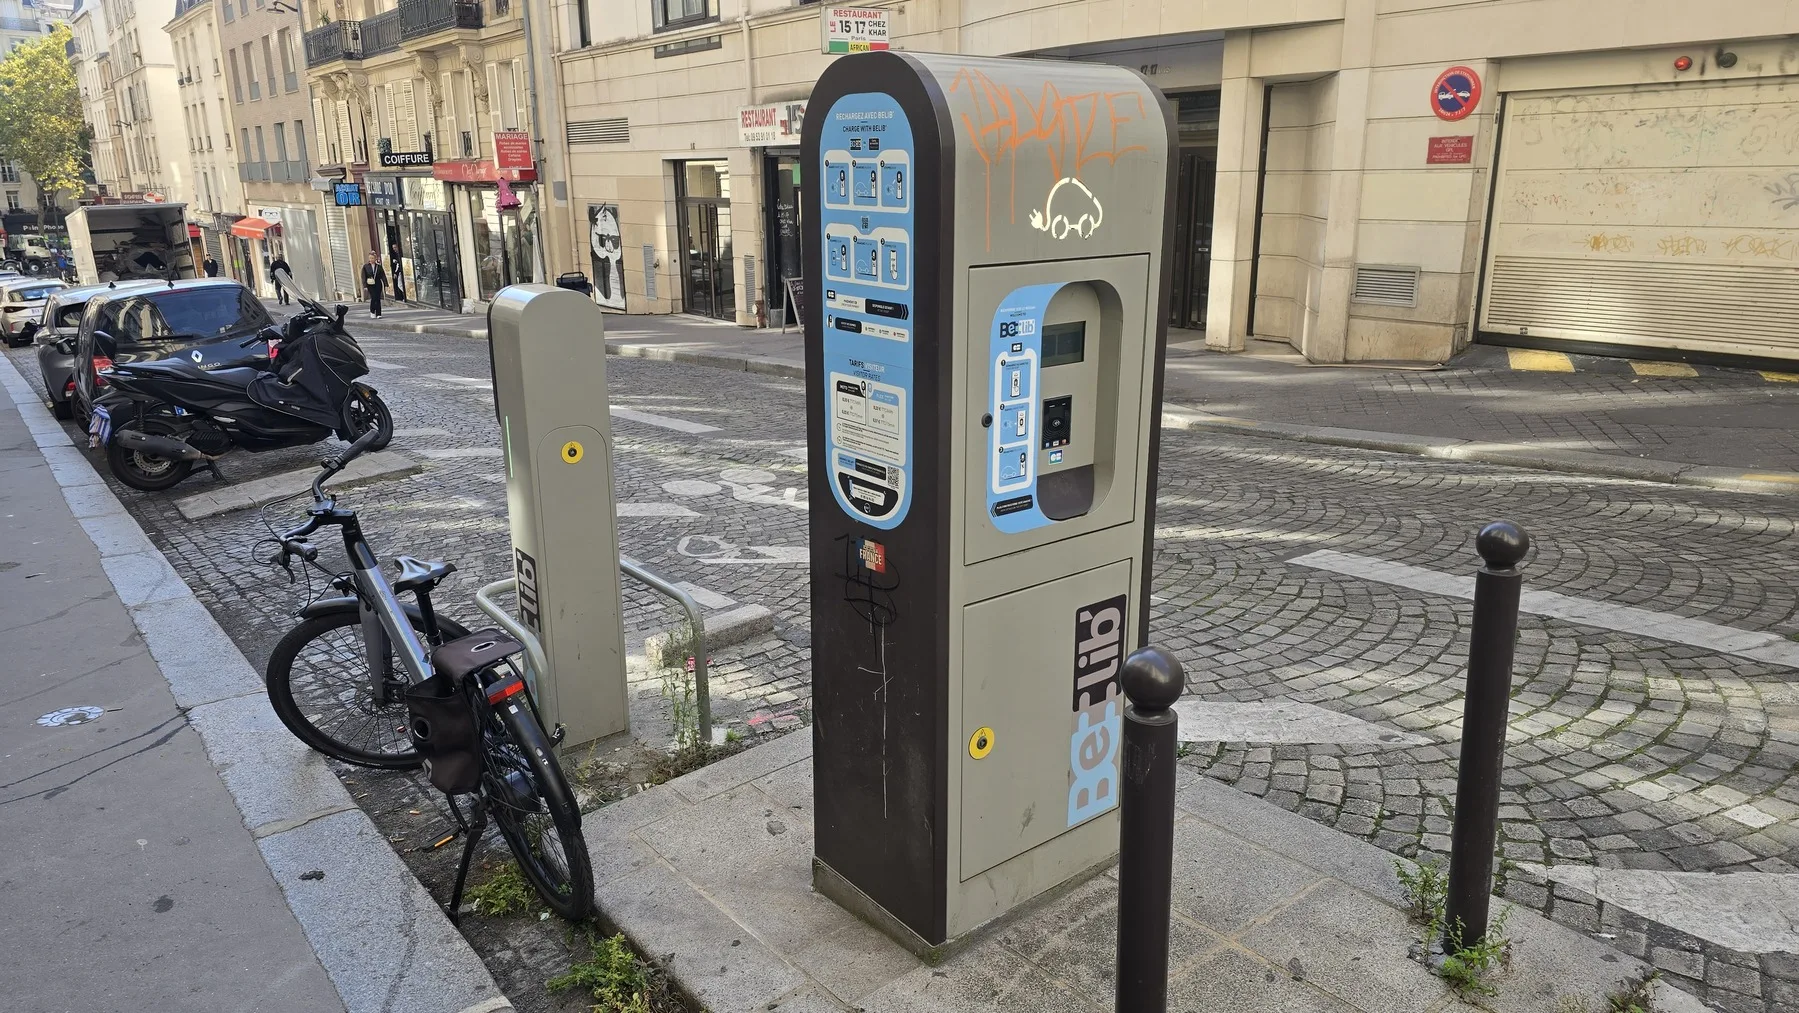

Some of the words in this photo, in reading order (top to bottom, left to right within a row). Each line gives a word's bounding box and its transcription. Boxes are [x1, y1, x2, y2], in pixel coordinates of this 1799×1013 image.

[833, 9, 882, 19] RESTAURANT
[830, 21, 837, 33] LE
[855, 21, 866, 34] 17
[868, 20, 886, 28] CHEZ
[741, 107, 776, 129] RESTAURANT
[836, 112, 864, 120] RECHARGEZ
[864, 111, 877, 119] AVEC
[384, 154, 430, 164] COIFFURE
[335, 192, 361, 205] OR
[849, 359, 864, 369] TARIFS
[859, 548, 882, 565] FRANCE
